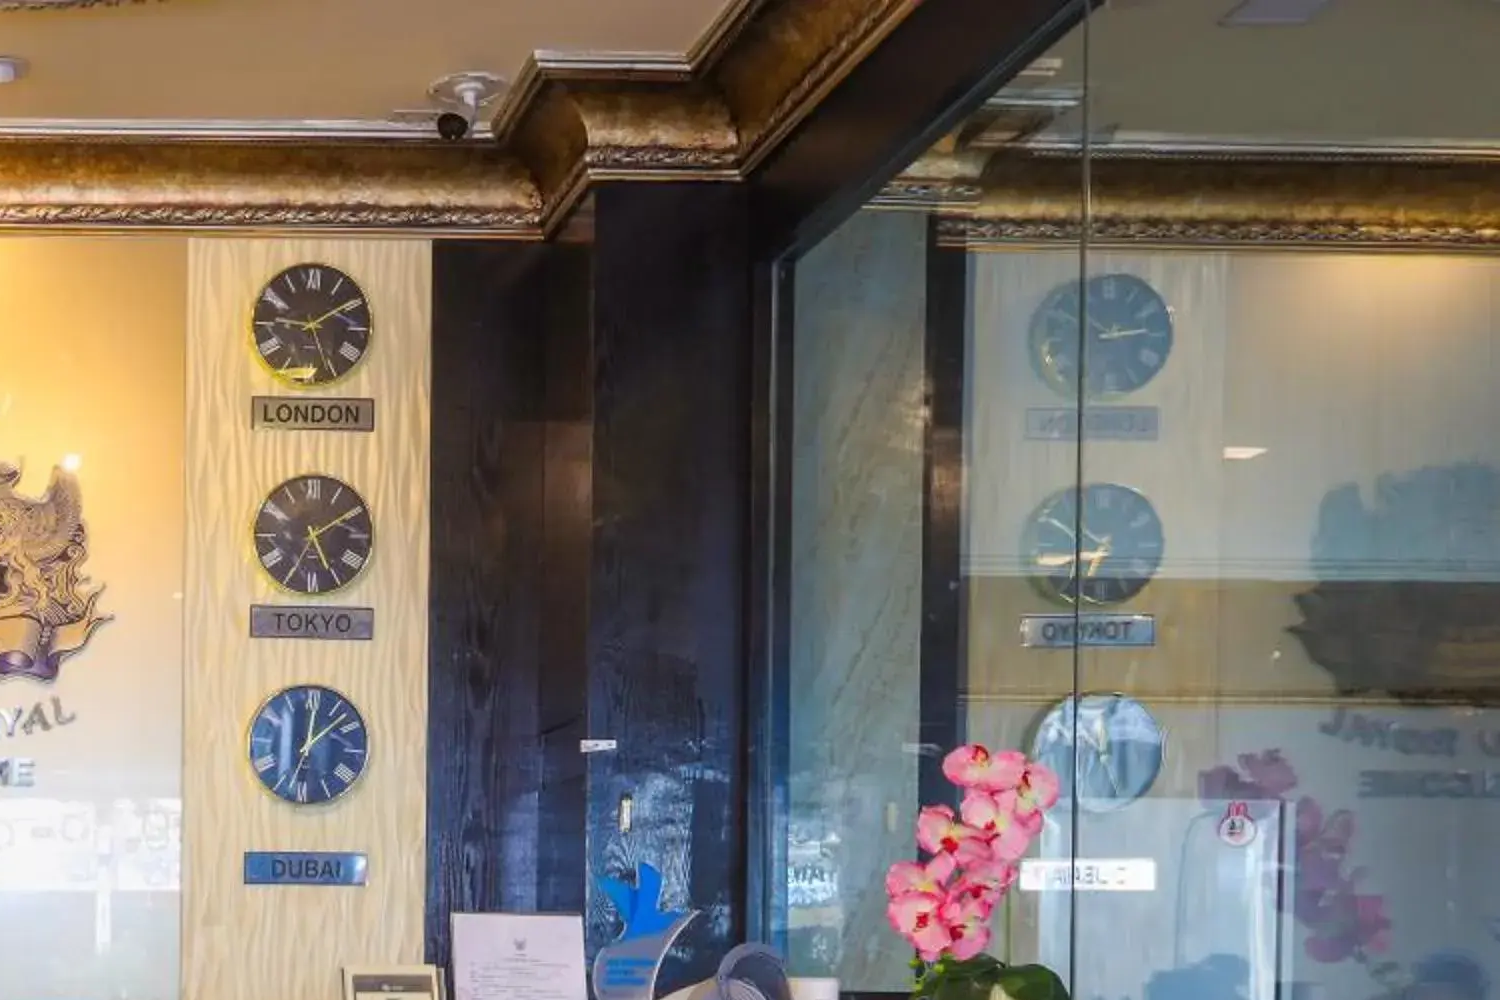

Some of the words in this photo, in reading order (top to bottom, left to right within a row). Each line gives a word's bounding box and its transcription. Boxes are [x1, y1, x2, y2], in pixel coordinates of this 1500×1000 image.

[263, 403, 360, 423] LONDON
[273, 613, 351, 633] TOKYO
[271, 859, 341, 878] DUBAI
